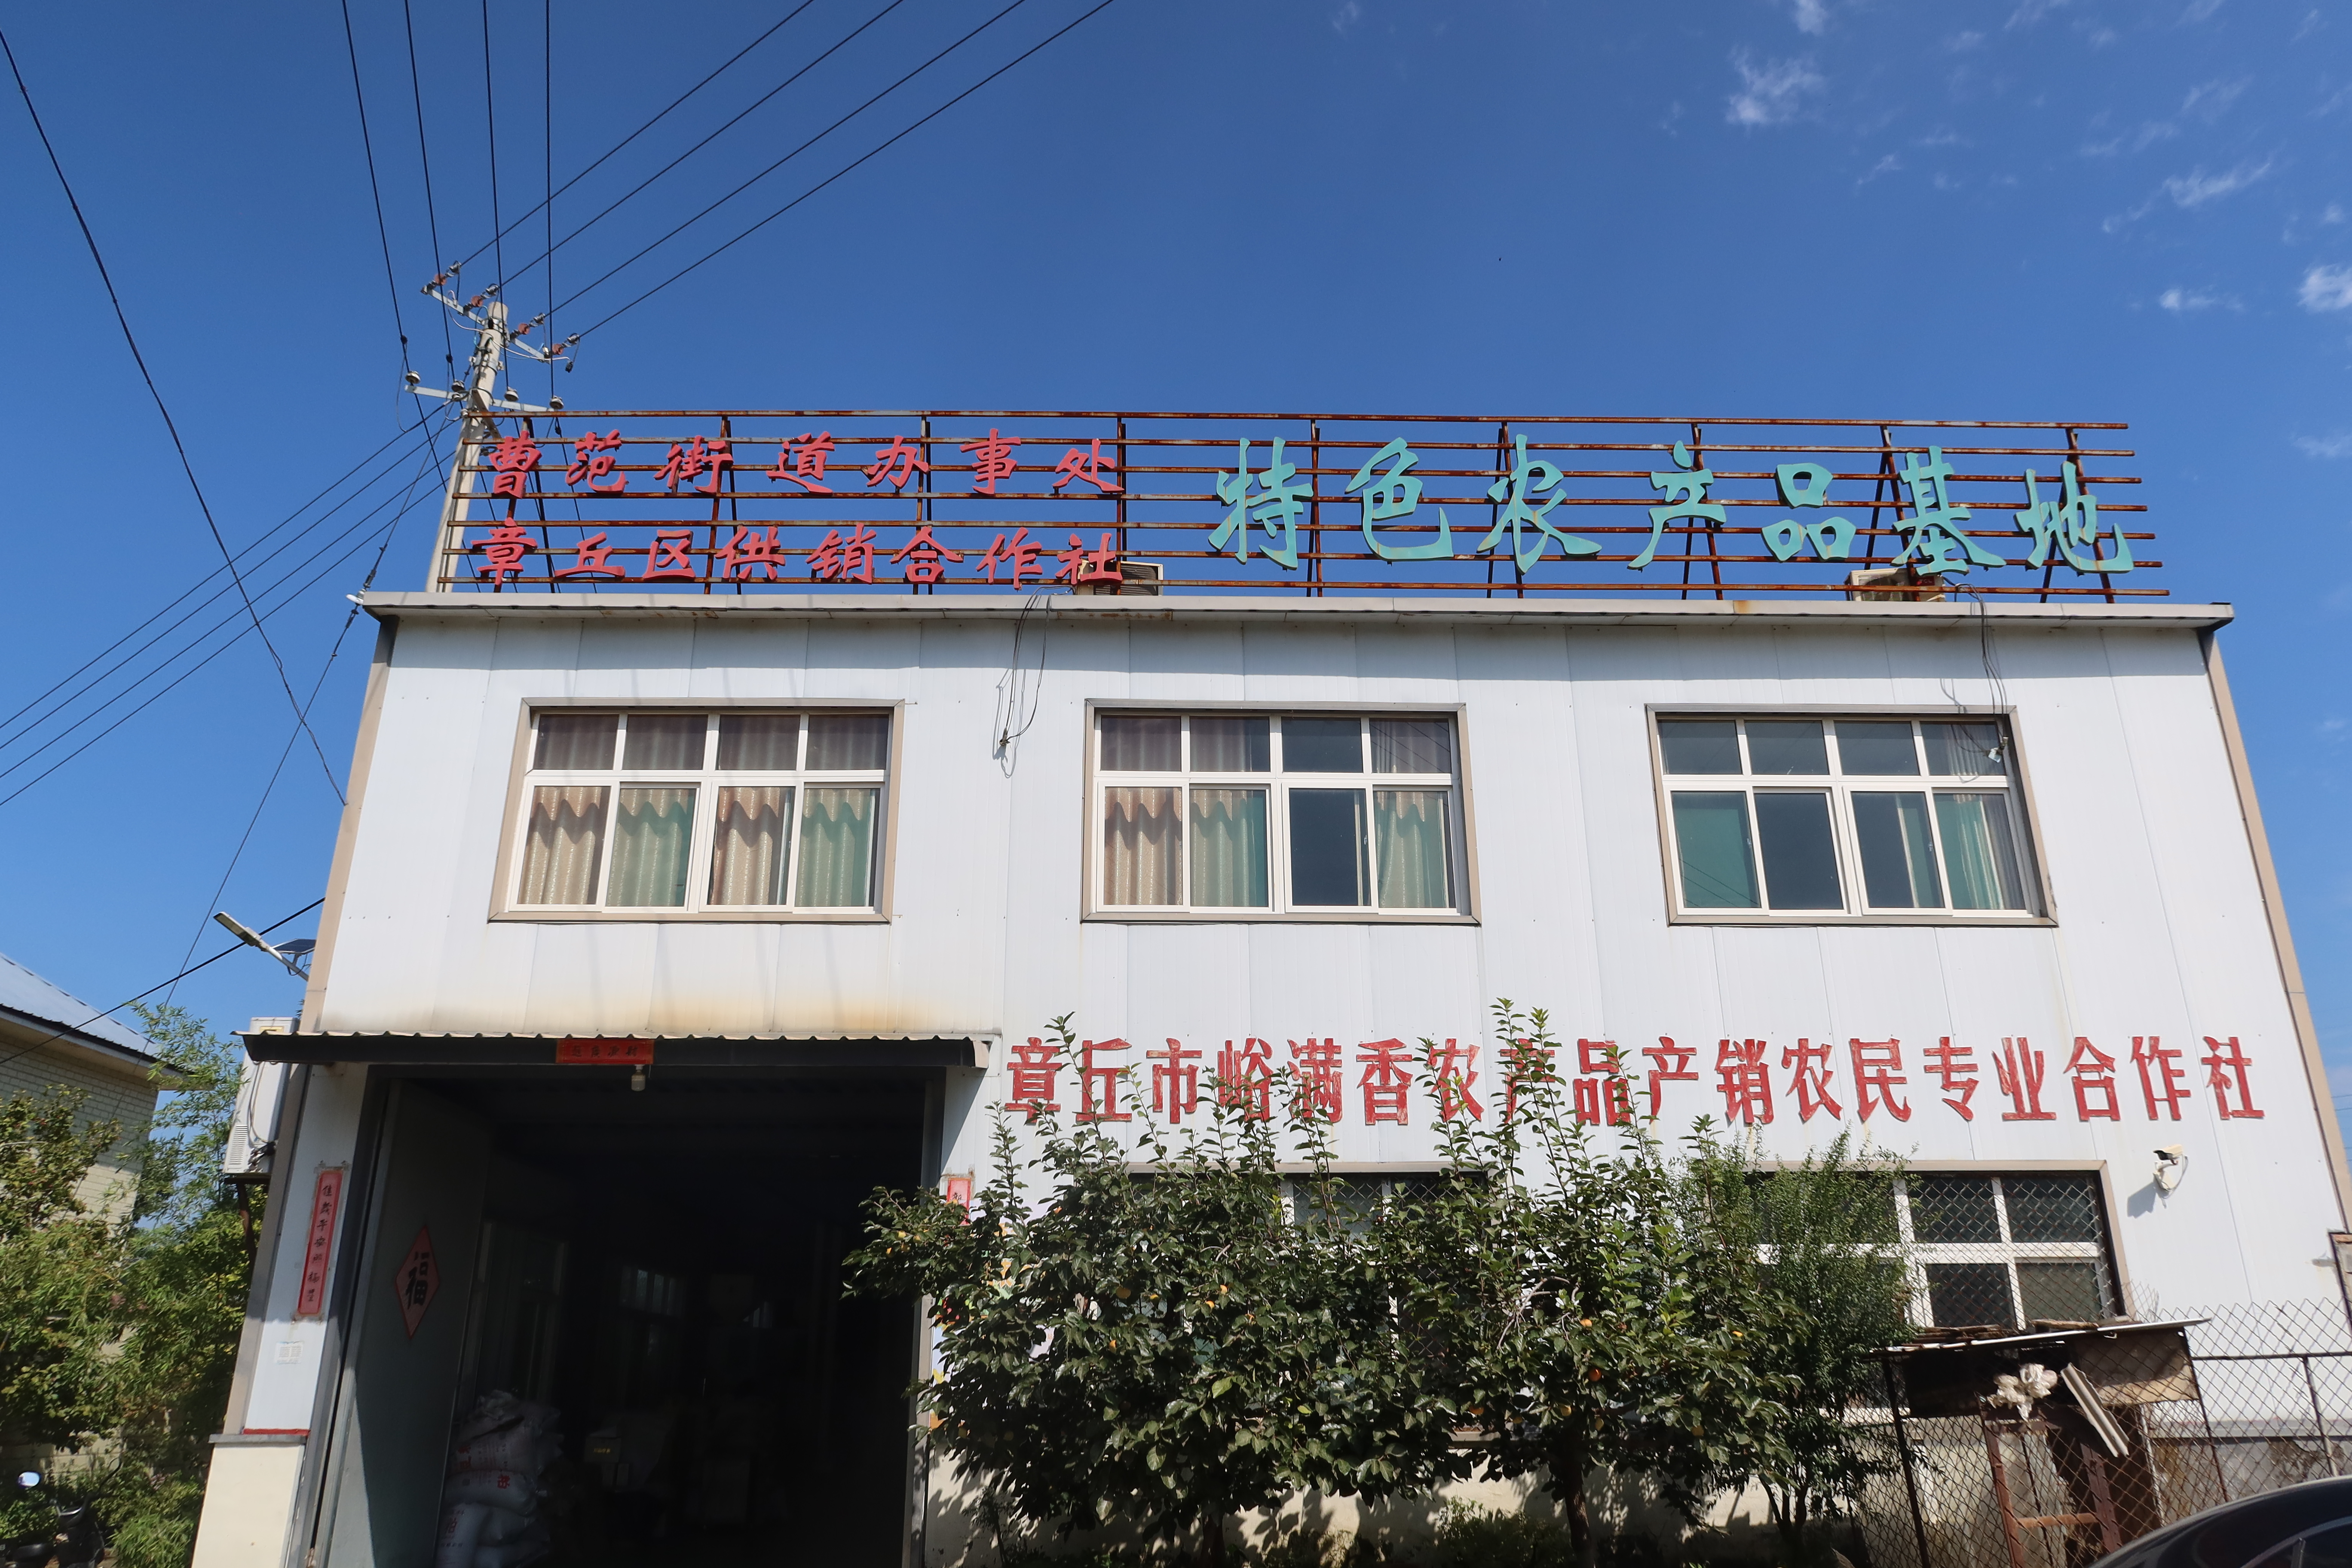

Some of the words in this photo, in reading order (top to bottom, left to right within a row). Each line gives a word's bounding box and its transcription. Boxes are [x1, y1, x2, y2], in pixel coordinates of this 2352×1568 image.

[489, 429, 1123, 499] 曹范街道办事处
[1209, 435, 2135, 575] 特色农产品基地
[472, 518, 1124, 590] 章丘区供销合作社
[405, 1251, 429, 1310] 福
